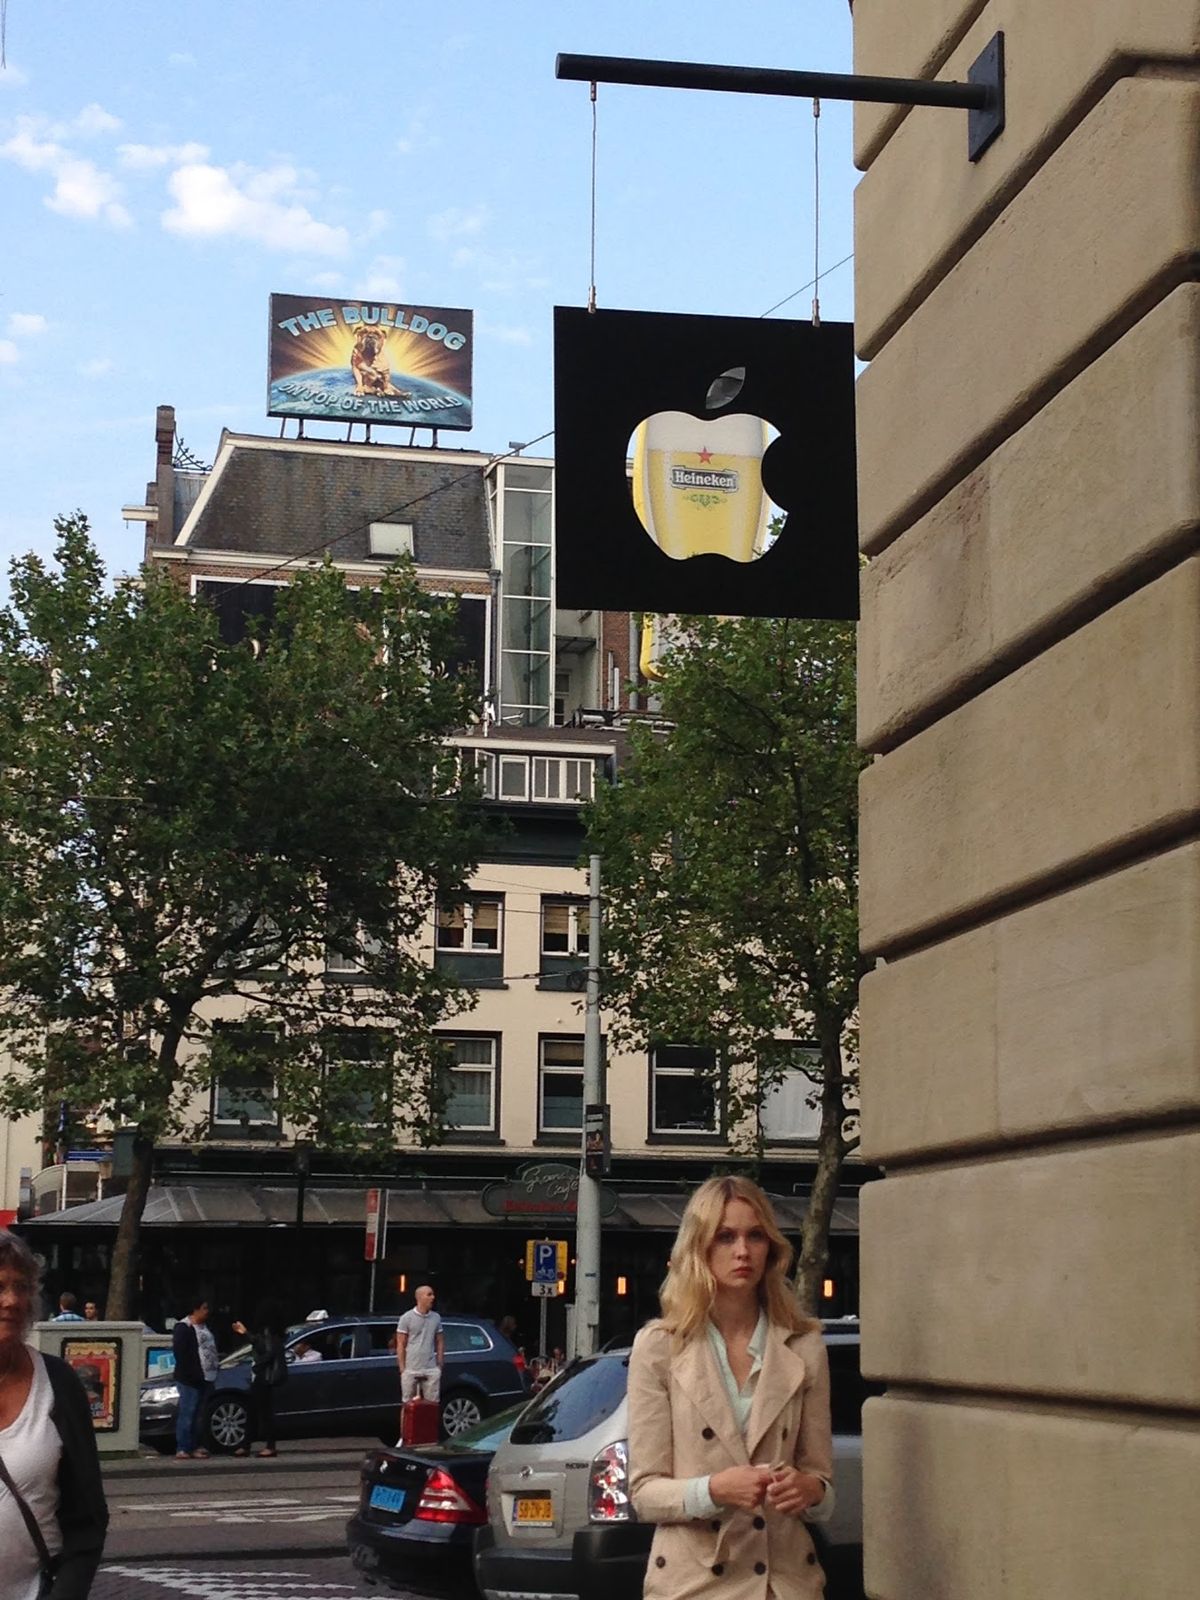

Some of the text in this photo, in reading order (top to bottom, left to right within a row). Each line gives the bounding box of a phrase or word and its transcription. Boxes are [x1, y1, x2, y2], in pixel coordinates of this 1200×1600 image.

[278, 306, 467, 350] THE BULLDOG
[278, 383, 464, 414] ON TOP OF THE WORLD
[675, 470, 735, 487] Heineken
[539, 1245, 553, 1265] P
